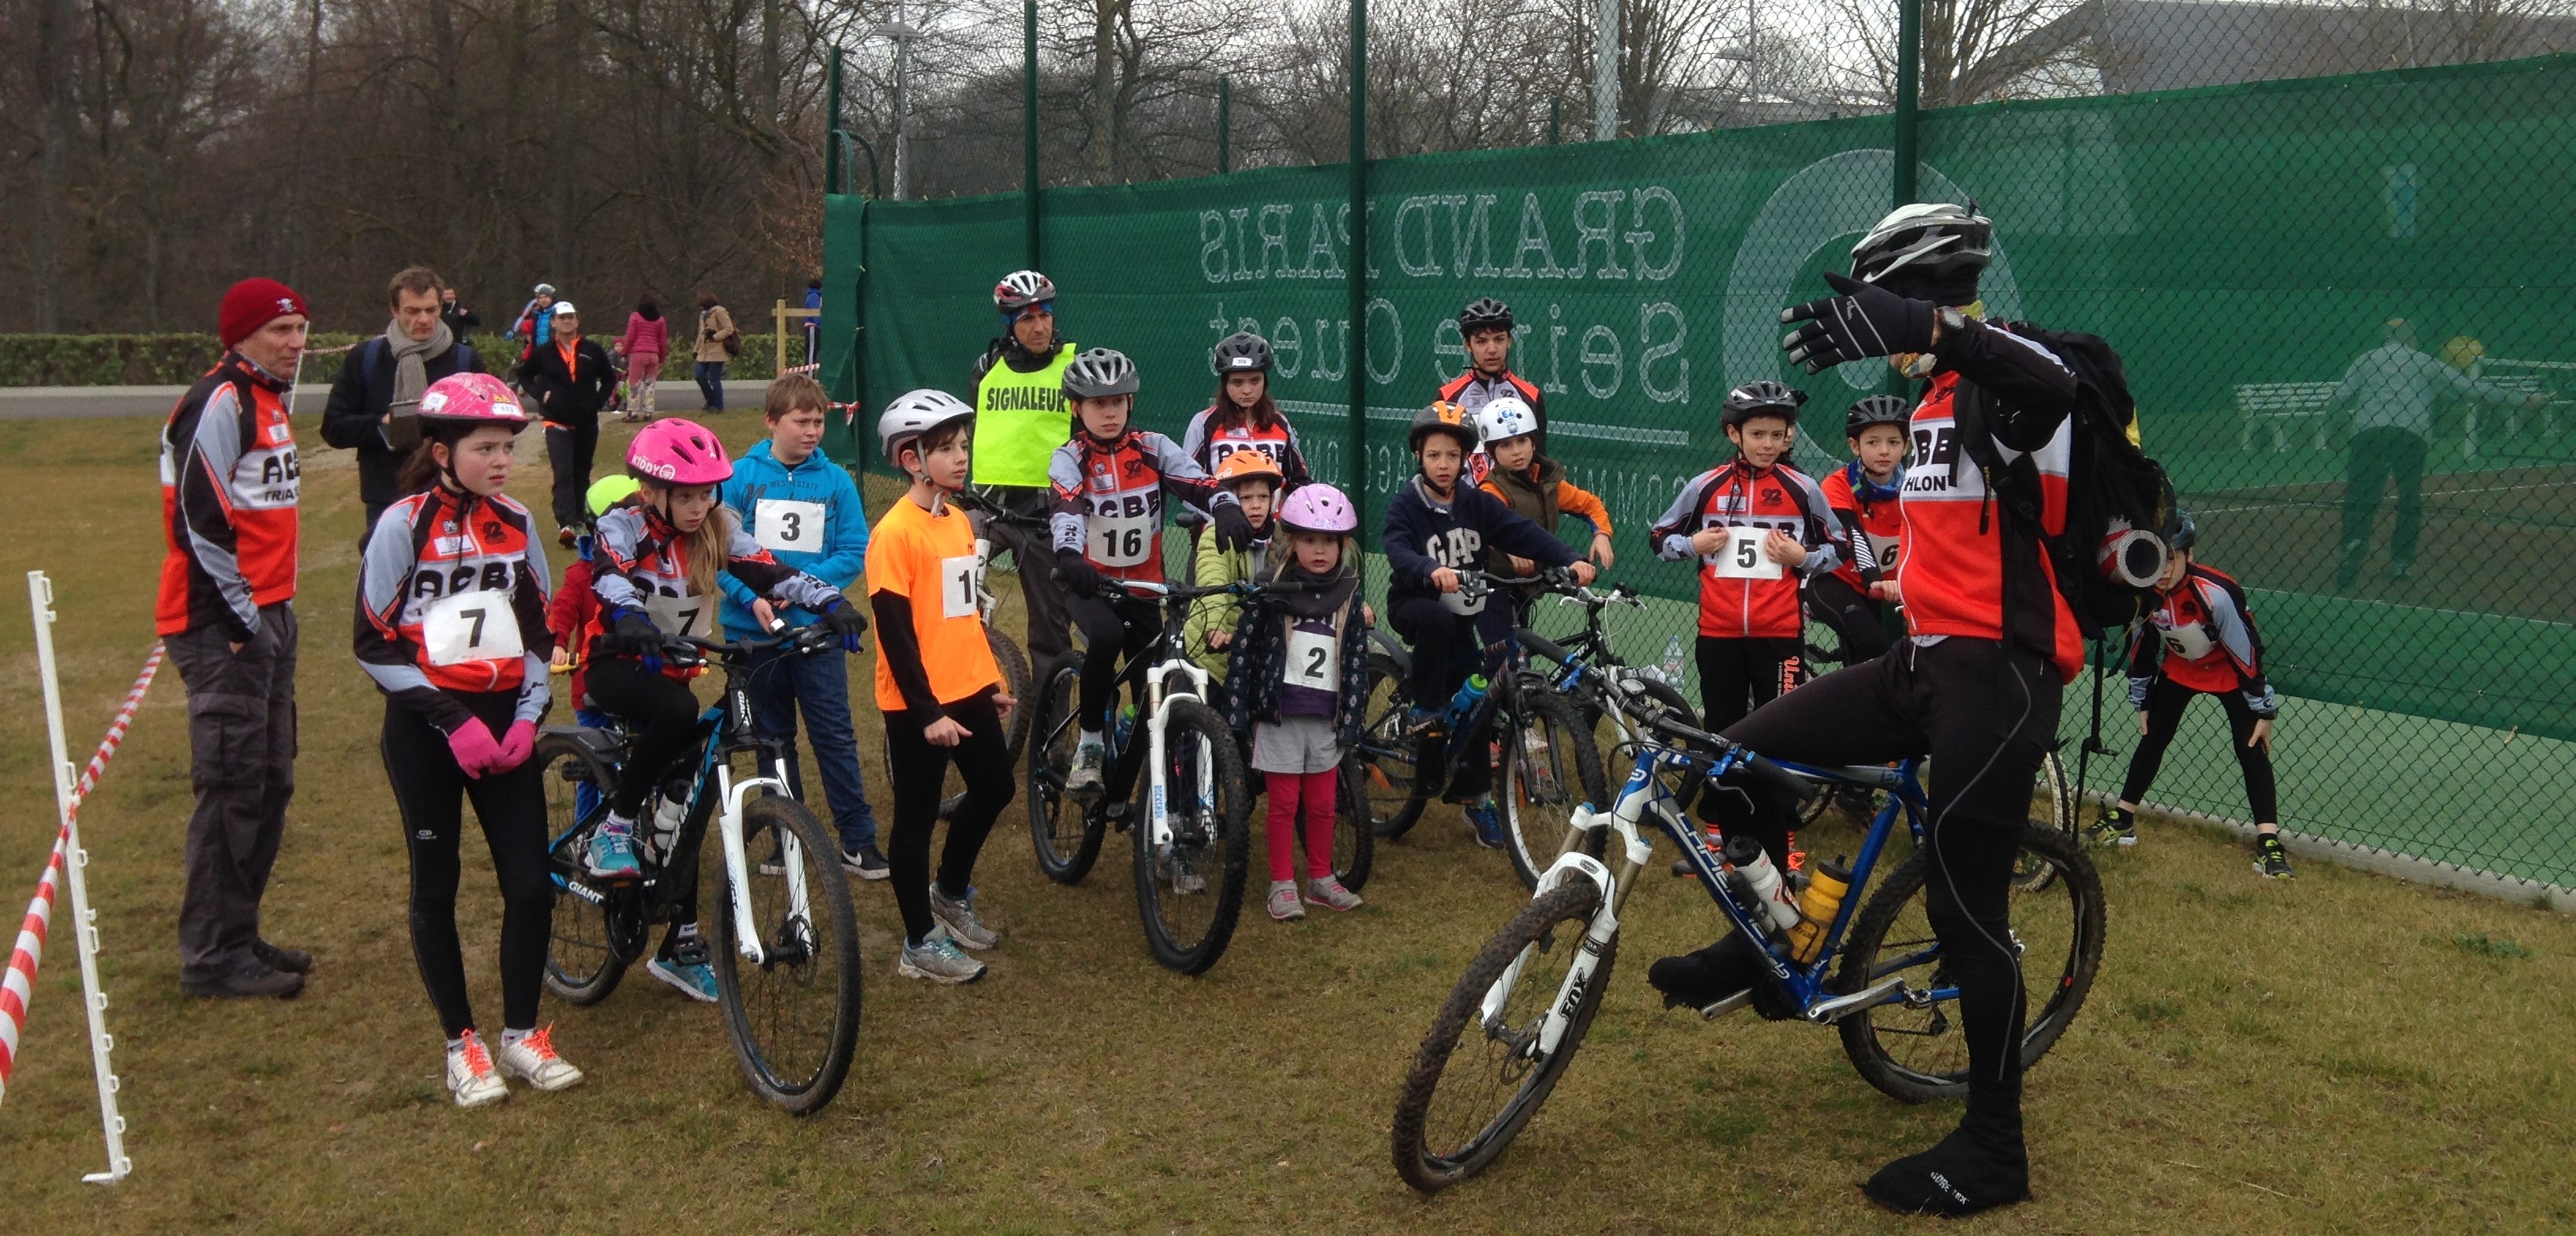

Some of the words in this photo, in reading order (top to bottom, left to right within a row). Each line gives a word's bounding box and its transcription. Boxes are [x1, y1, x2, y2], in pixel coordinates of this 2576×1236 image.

[987, 386, 1065, 412] SIGNALEUR
[1904, 475, 1946, 492] HLON
[781, 512, 800, 541] 3
[1103, 528, 1141, 557] 16
[1426, 527, 1481, 567] GAP
[1737, 539, 1757, 568] 5
[1881, 544, 1900, 566] 6
[460, 608, 486, 648] 7
[678, 607, 700, 636] 7
[1305, 647, 1327, 679] 2
[568, 881, 604, 904] GIANT
[1559, 971, 1587, 1018] FOX
